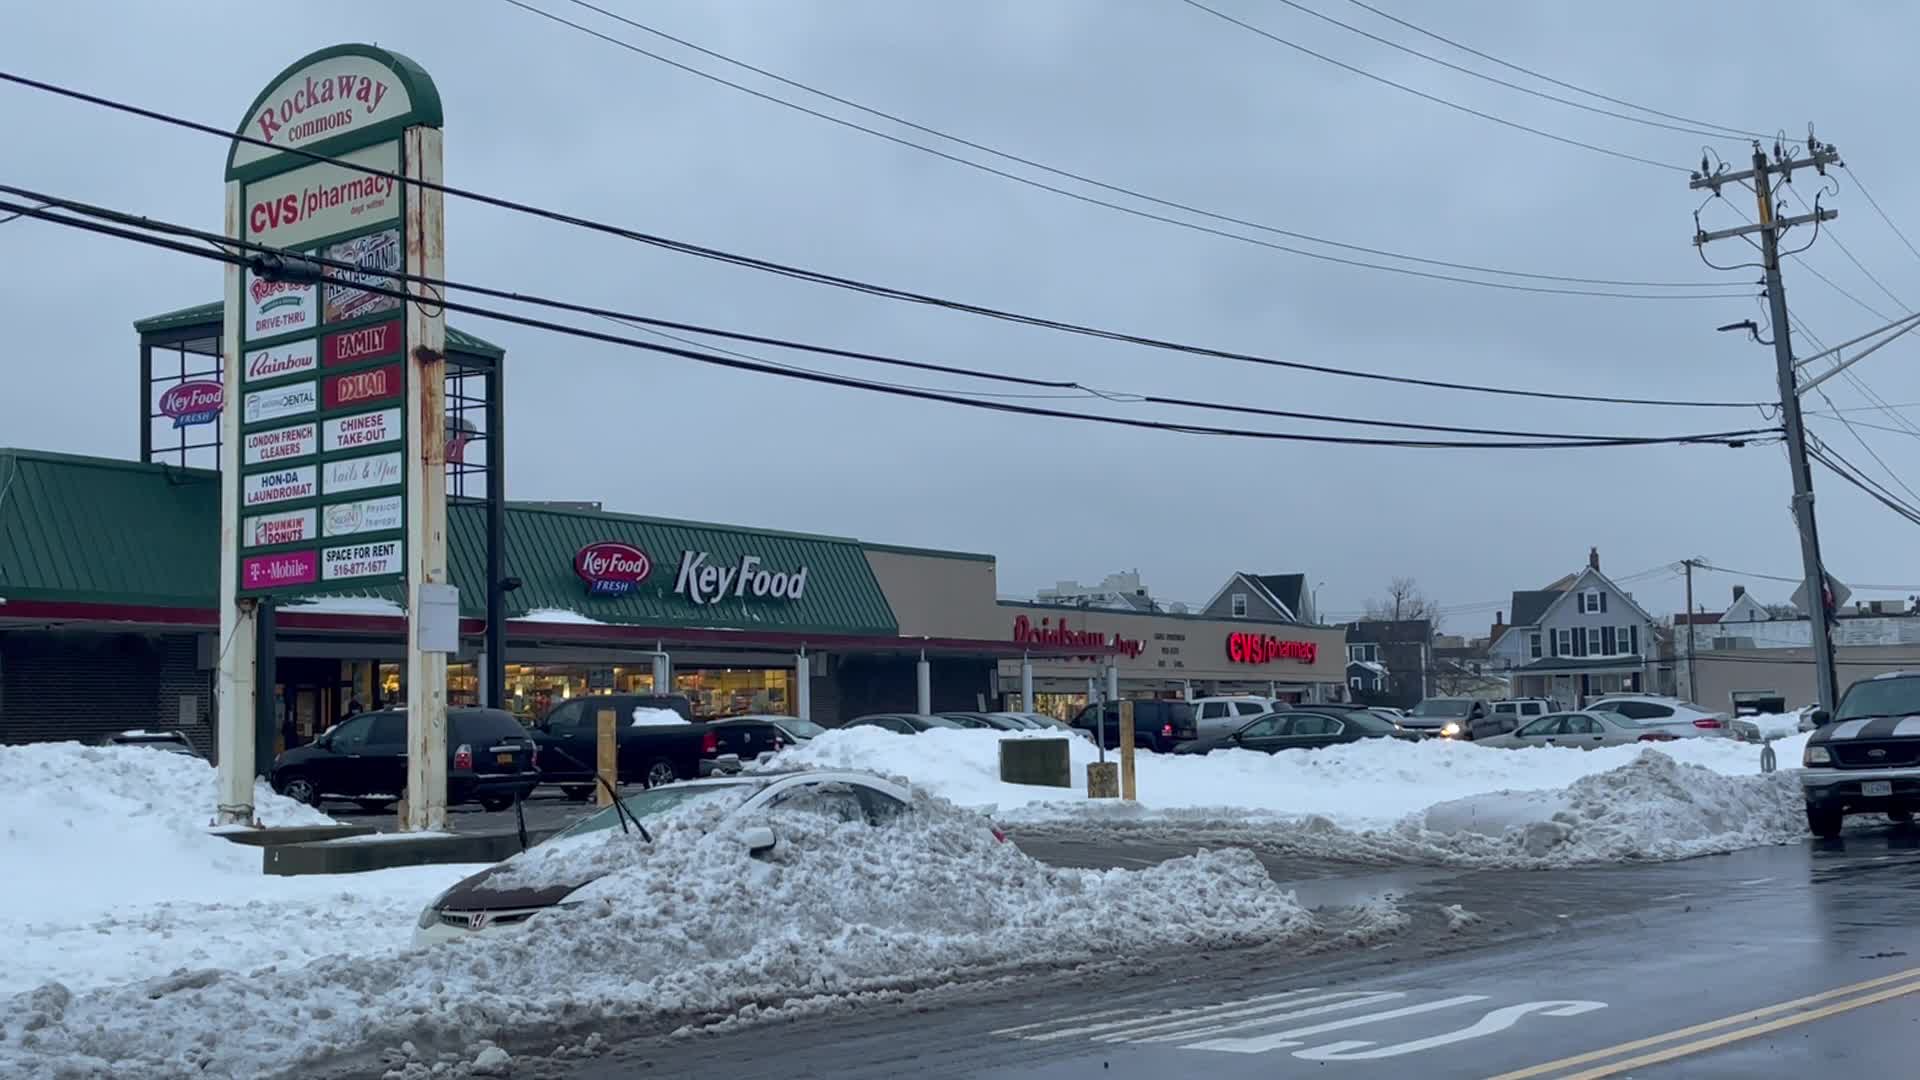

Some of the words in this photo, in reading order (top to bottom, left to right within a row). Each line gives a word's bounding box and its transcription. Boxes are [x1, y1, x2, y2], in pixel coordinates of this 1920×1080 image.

[257, 74, 389, 142] Rockaway
[288, 108, 353, 142] commons
[251, 171, 395, 233] CVS/pharmacy
[256, 311, 305, 332] DRIVE-THRU
[337, 326, 387, 359] FAMILY
[250, 351, 312, 377] Rainbow
[281, 391, 315, 407] DENTAL
[340, 414, 383, 432] CHINESE
[248, 430, 280, 448] LONDON
[281, 426, 313, 442] FRENCH
[337, 428, 387, 447] TAKE-OUT
[260, 443, 301, 460] CLEANERS
[261, 471, 299, 488] HON-DA
[248, 483, 312, 503] LAUNDROMAT
[268, 529, 303, 544] DONUTS
[326, 548, 352, 562] SPACE
[353, 546, 372, 559] FOR
[373, 543, 395, 557] RENT
[333, 560, 387, 576] 516-877-1677
[597, 580, 629, 591] FRESH
[1227, 632, 1318, 665] CVS/pharmacy
